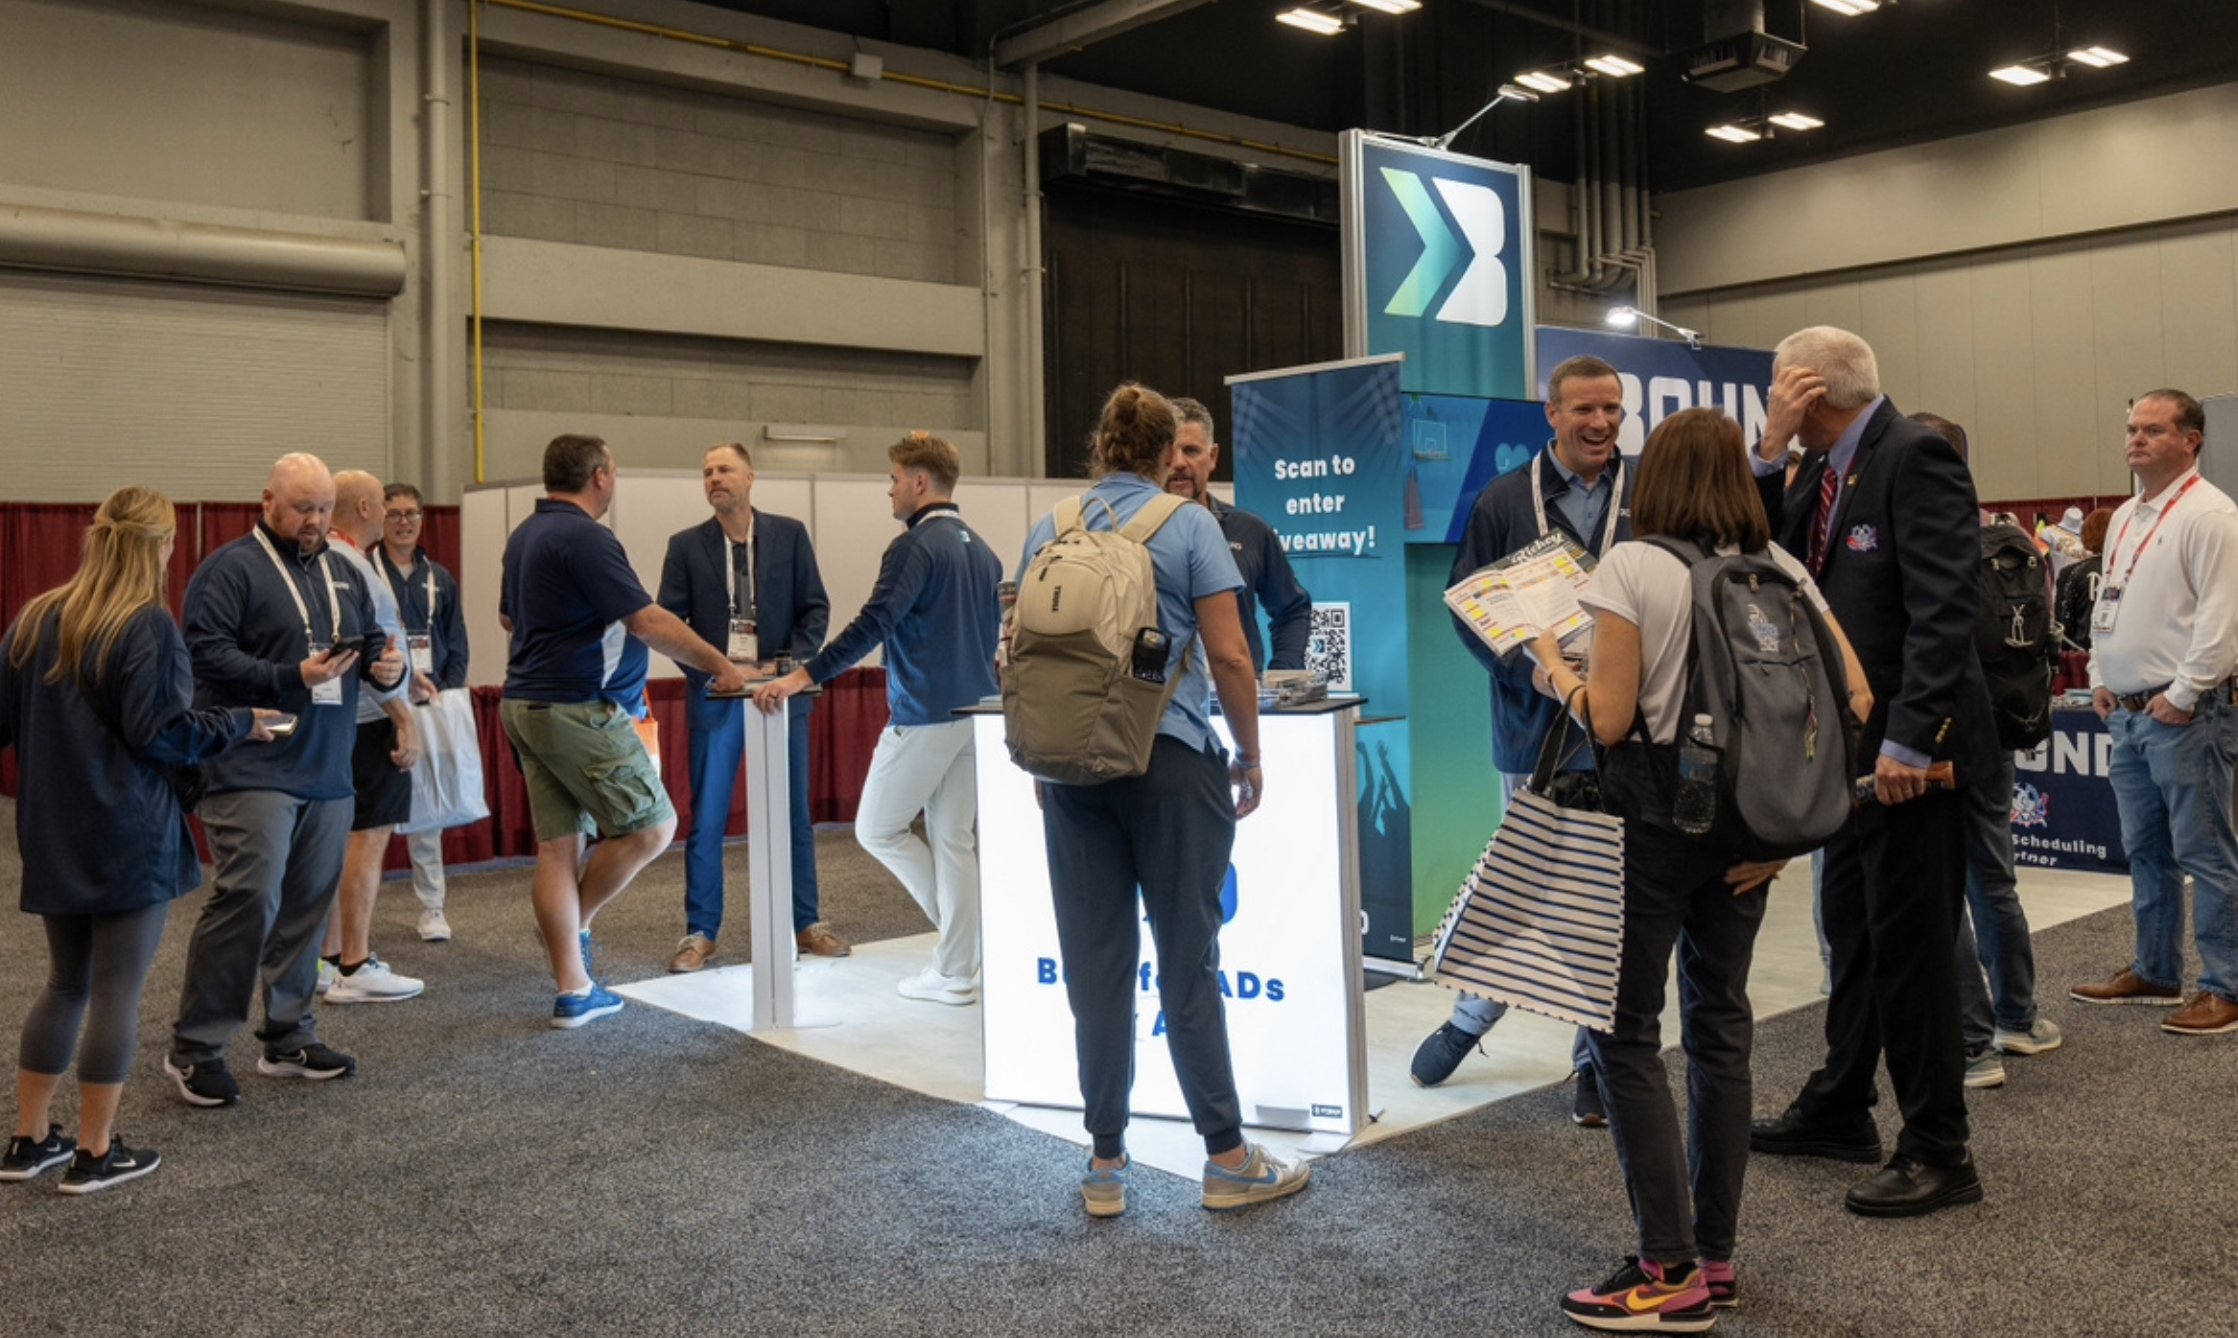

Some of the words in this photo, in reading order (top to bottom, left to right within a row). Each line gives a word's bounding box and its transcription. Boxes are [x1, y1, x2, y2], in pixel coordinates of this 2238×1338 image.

[1275, 459, 1328, 480] Scan
[1332, 455, 1355, 475] to
[1286, 493, 1345, 515] enter
[1273, 525, 1376, 556] veaway!
[2011, 834, 2108, 860] Scheduling
[2013, 850, 2058, 867] rtner
